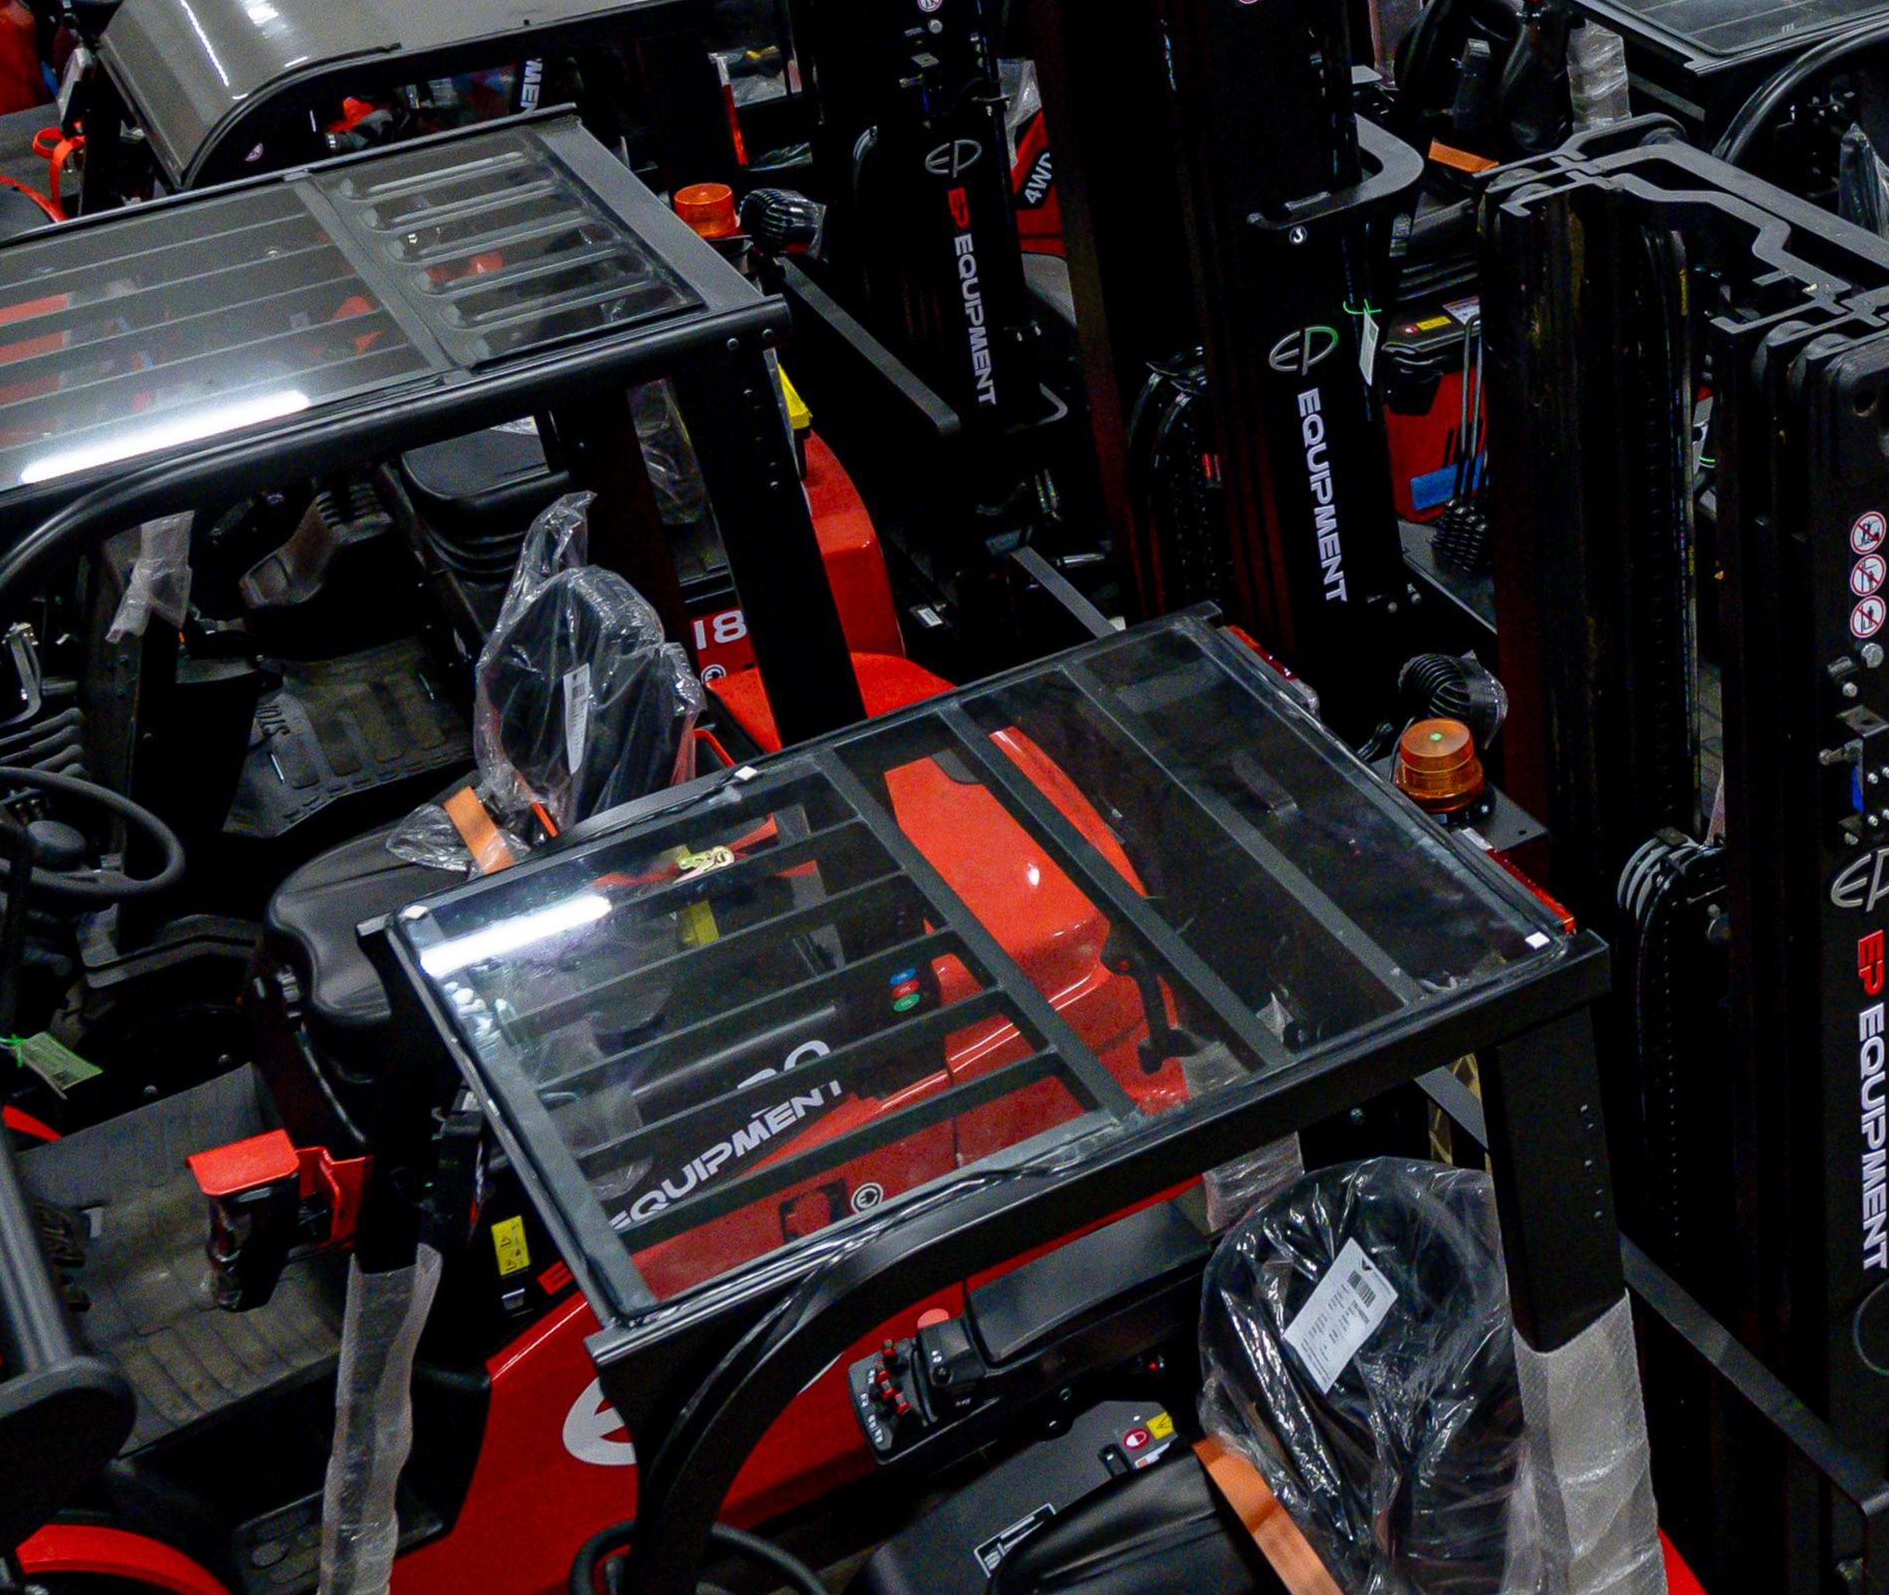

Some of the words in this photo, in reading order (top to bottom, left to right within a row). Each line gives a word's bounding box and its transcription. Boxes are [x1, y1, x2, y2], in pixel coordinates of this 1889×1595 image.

[924, 138, 983, 180] EP
[953, 231, 998, 407] EQUIPMENT
[1267, 324, 1341, 377] EP
[1296, 386, 1349, 605] EQUIPMENT
[692, 608, 749, 652] 18
[1856, 928, 1885, 997] EP
